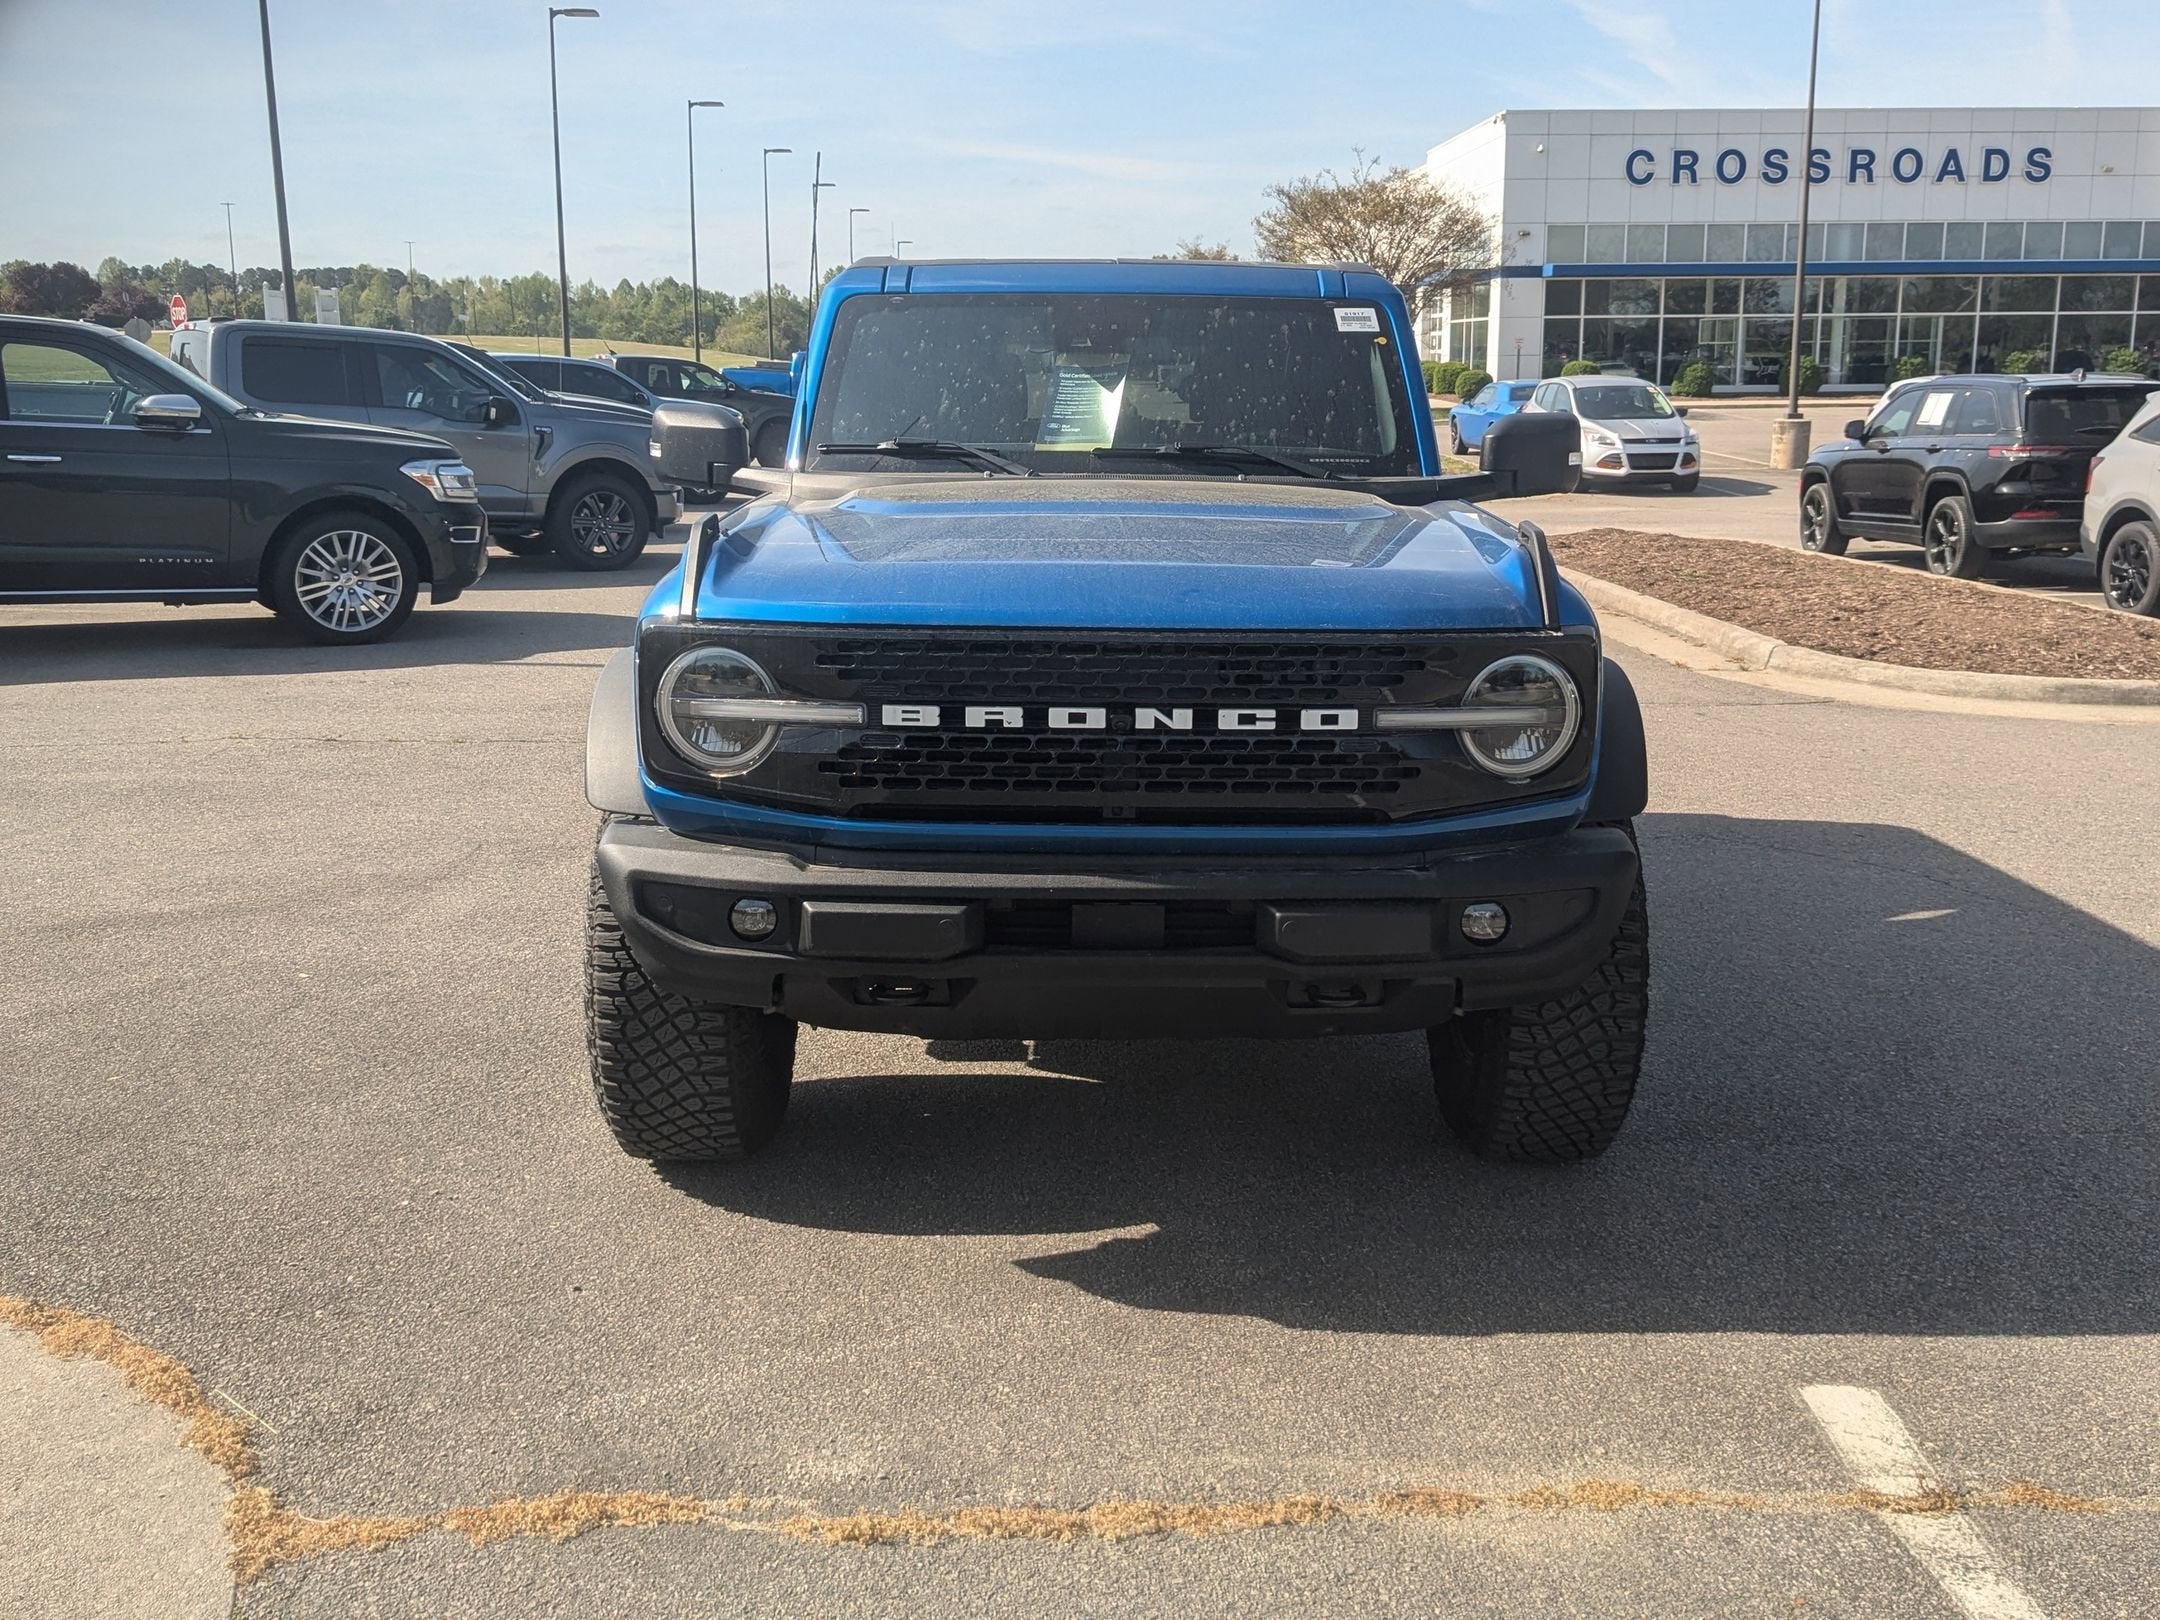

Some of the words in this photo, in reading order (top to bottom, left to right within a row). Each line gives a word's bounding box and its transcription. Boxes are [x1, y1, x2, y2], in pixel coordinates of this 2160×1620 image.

[1624, 146, 2053, 186] CROSSROADS
[171, 306, 186, 321] STOP
[882, 704, 1359, 730] BRONCO
